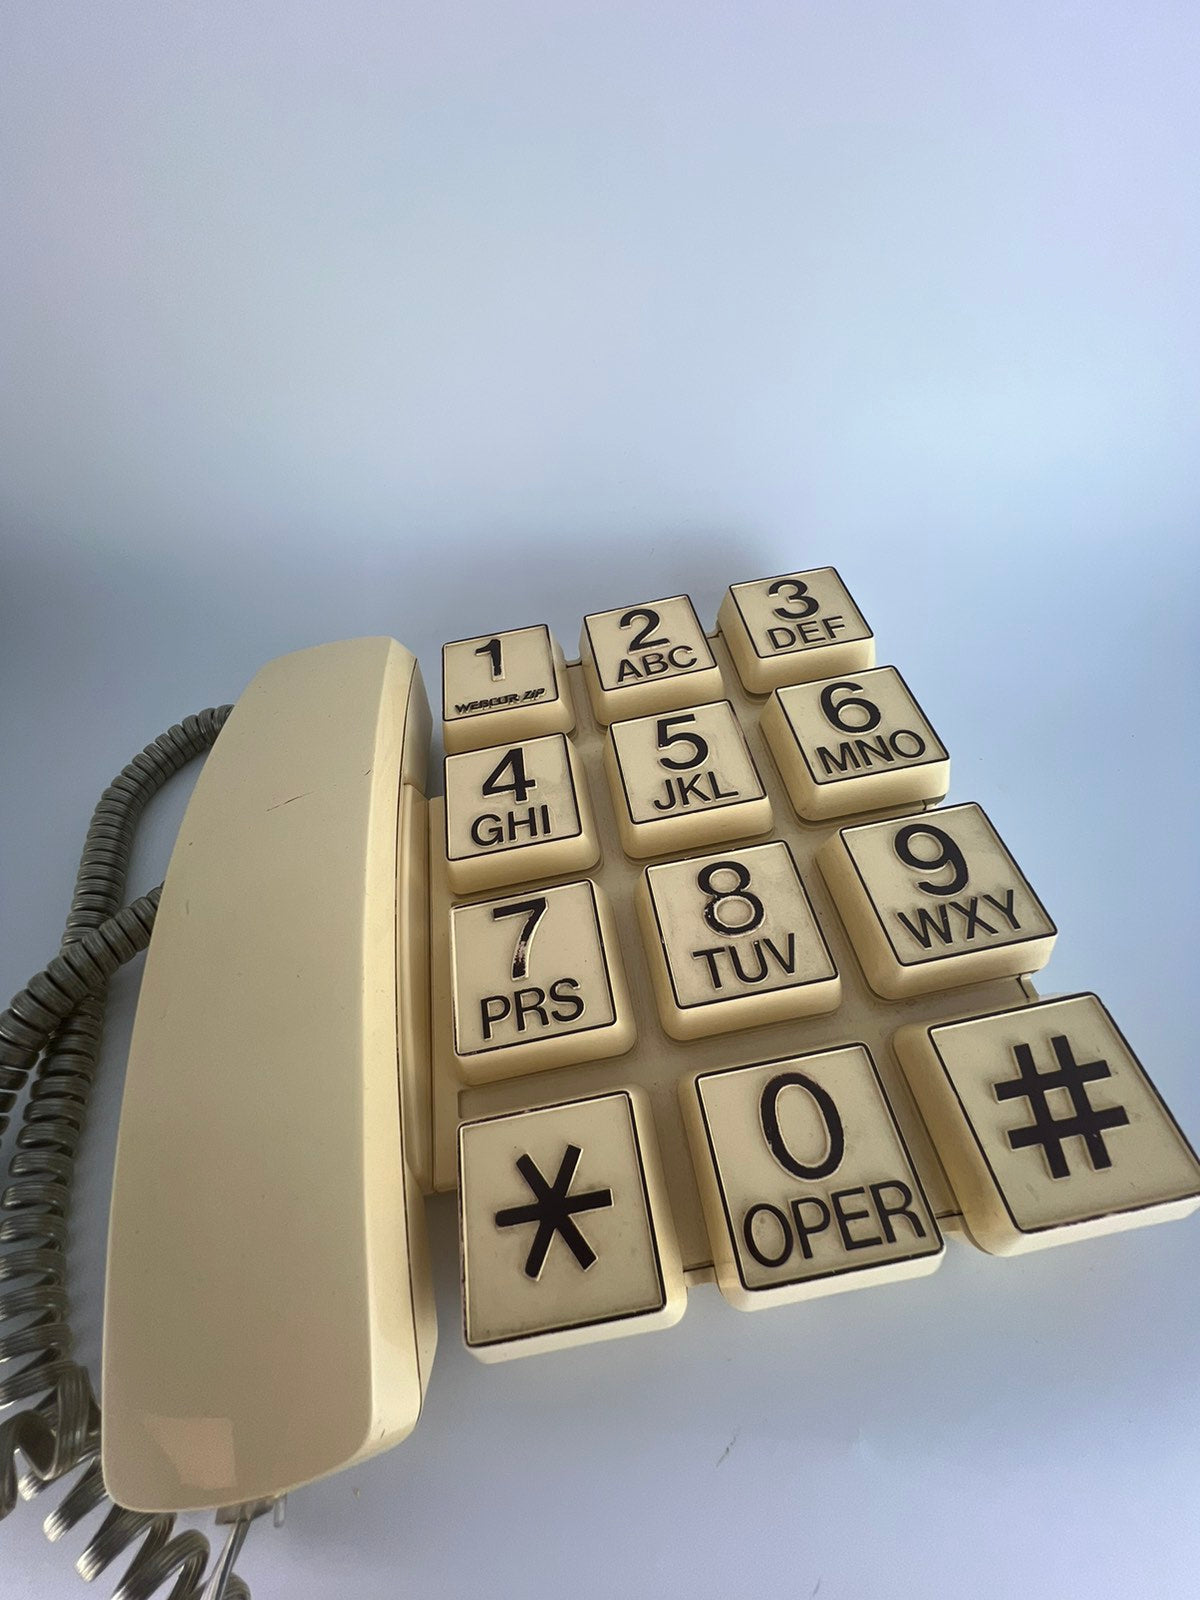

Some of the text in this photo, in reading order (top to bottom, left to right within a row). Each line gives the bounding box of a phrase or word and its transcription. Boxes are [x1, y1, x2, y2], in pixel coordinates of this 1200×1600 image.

[768, 580, 819, 619] 3
[619, 609, 670, 652] 2
[767, 616, 845, 649] DEF
[475, 639, 504, 680] 1
[618, 646, 697, 682] ABC
[455, 688, 546, 714] WEBCOR ZIP
[821, 682, 881, 733] 6
[657, 714, 708, 770] 5
[817, 730, 925, 774] MNO
[482, 748, 535, 801] 4
[654, 771, 739, 810] JKL
[471, 805, 550, 846] GHI
[895, 824, 969, 895] 9
[697, 861, 764, 936] 8
[897, 889, 1021, 948] WXY
[491, 897, 546, 978] 7
[693, 933, 794, 988] TUV
[481, 978, 584, 1039] PRS
[761, 1072, 844, 1180] 0
[994, 1035, 1130, 1179] #
[743, 1180, 926, 1268] OPER
